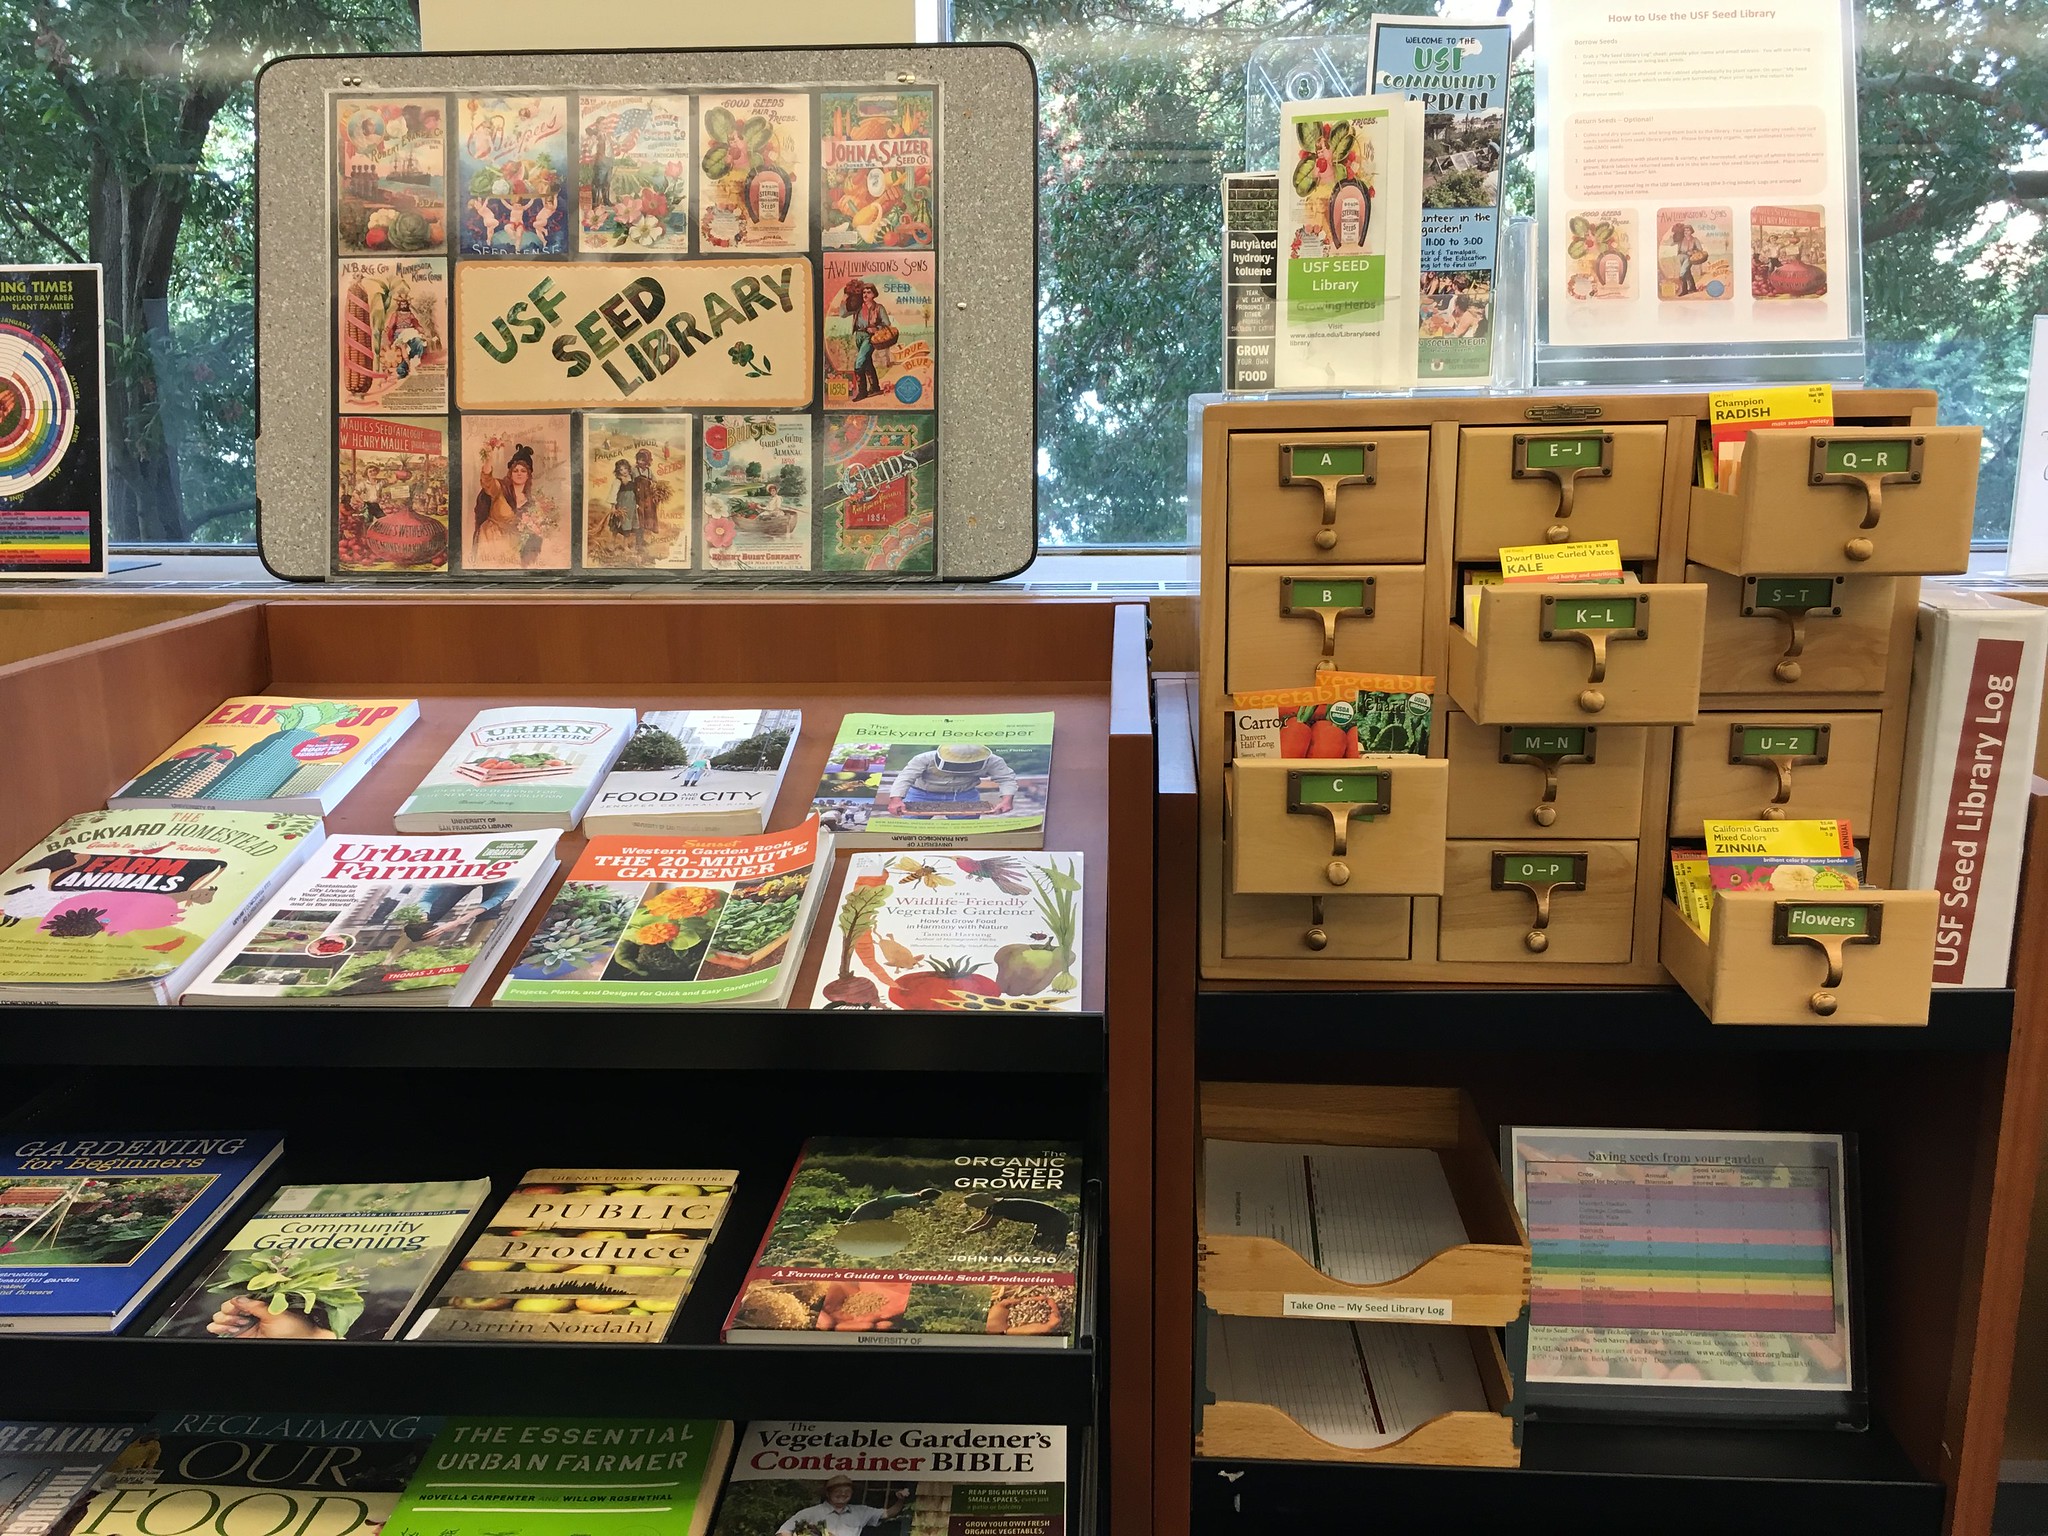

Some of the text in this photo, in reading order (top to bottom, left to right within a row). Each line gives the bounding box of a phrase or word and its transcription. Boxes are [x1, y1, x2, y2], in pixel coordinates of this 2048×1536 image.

[1608, 14, 1632, 22] How
[1648, 12, 1667, 21] Use
[1670, 12, 1687, 20] the
[1690, 12, 1710, 20] USF
[1712, 10, 1737, 19] Seed
[1740, 9, 1776, 19] Library
[826, 140, 929, 166] JOHN SALZER
[1474, 213, 1490, 222] the
[1230, 240, 1276, 251] Butylated
[1449, 238, 1459, 246] to
[1236, 266, 1272, 276] toluene
[1303, 260, 1370, 272] USF SEED
[32, 281, 73, 292] TIMES
[1312, 279, 1359, 292] Library
[34, 294, 74, 302] BAY AREA
[896, 296, 932, 304] ANNUAL
[12, 303, 38, 311] PLANT
[474, 276, 566, 364] USF
[551, 276, 666, 378] SEED
[601, 267, 793, 397] LIBRARY
[898, 342, 922, 360] TRUE
[1236, 345, 1269, 356] GROW
[906, 358, 929, 371] BLUE
[1239, 371, 1267, 381] FOOD
[70, 374, 80, 399] MARCH
[830, 384, 846, 396] 1895
[1715, 398, 1764, 408] Champion
[1716, 407, 1770, 420] RADISH
[352, 433, 408, 450] HENRY MAULE
[1320, 453, 1332, 466] A
[1506, 554, 1532, 562] Dwarf
[1557, 550, 1586, 558] Curled
[1590, 548, 1614, 556] Vates
[1508, 562, 1544, 574] KALE
[1323, 590, 1332, 602] B
[486, 724, 596, 736] URBAN
[856, 728, 1034, 738] Backyard Beekeeper
[485, 734, 592, 742] AGRICULTURE
[1332, 779, 1344, 792] C
[602, 792, 761, 802] FOOD CITY
[171, 812, 204, 822] THE
[1936, 674, 2013, 966] USF Seed Library Log
[47, 823, 278, 856] BACKYARD HOMESTEAD
[682, 840, 742, 848] Sunset
[754, 840, 793, 852] Book
[333, 844, 462, 863] Urban
[594, 842, 809, 866] THE 20-MINUTE
[1715, 844, 1767, 853] ZINNIA
[83, 857, 190, 875] FARM
[322, 860, 518, 880] Farming
[617, 863, 775, 878] GARDENER
[54, 872, 186, 892] ANIMALS
[886, 907, 1034, 916] Vegetable Gardener
[1792, 911, 1855, 927] Flowers
[388, 966, 456, 980] THOMAS FOX
[722, 978, 768, 992] Gardening
[15, 1138, 247, 1156] GARDENING
[1042, 1150, 1066, 1158] The
[1588, 1150, 1764, 1166] Saving seeds from your garden
[18, 1156, 206, 1172] for Beginners
[954, 1157, 1065, 1168] ORGANIC
[1002, 1168, 1064, 1178] SEED
[954, 1178, 1063, 1190] GROWER
[528, 1203, 710, 1220] PUBLIC
[281, 1221, 424, 1234] Community
[254, 1232, 430, 1250] Gardening
[500, 1241, 690, 1259] Produce
[948, 1254, 1056, 1264] JOHN NAVAZIO
[843, 1272, 880, 1280] Guide
[898, 1274, 954, 1283] Vegetable
[988, 1276, 1055, 1284] Production
[1290, 1301, 1444, 1316] Take One My Seed Library Log
[448, 1320, 653, 1334] Darrin Nordahl
[858, 1336, 908, 1344] UNIVERSITY
[172, 1414, 421, 1440] RECLAIMING
[789, 1422, 816, 1432] The
[454, 1424, 694, 1445] THE ESSENTIAL
[758, 1430, 1052, 1452] Vegetable Gardener's
[178, 1440, 362, 1486] OUR
[437, 1452, 688, 1471] URBAN FARMER
[750, 1451, 1034, 1472] Container BIBLE
[418, 1494, 469, 1502] NOVELLA
[471, 1494, 536, 1502] CARPENTER
[609, 1494, 672, 1502] ROSENTHAL
